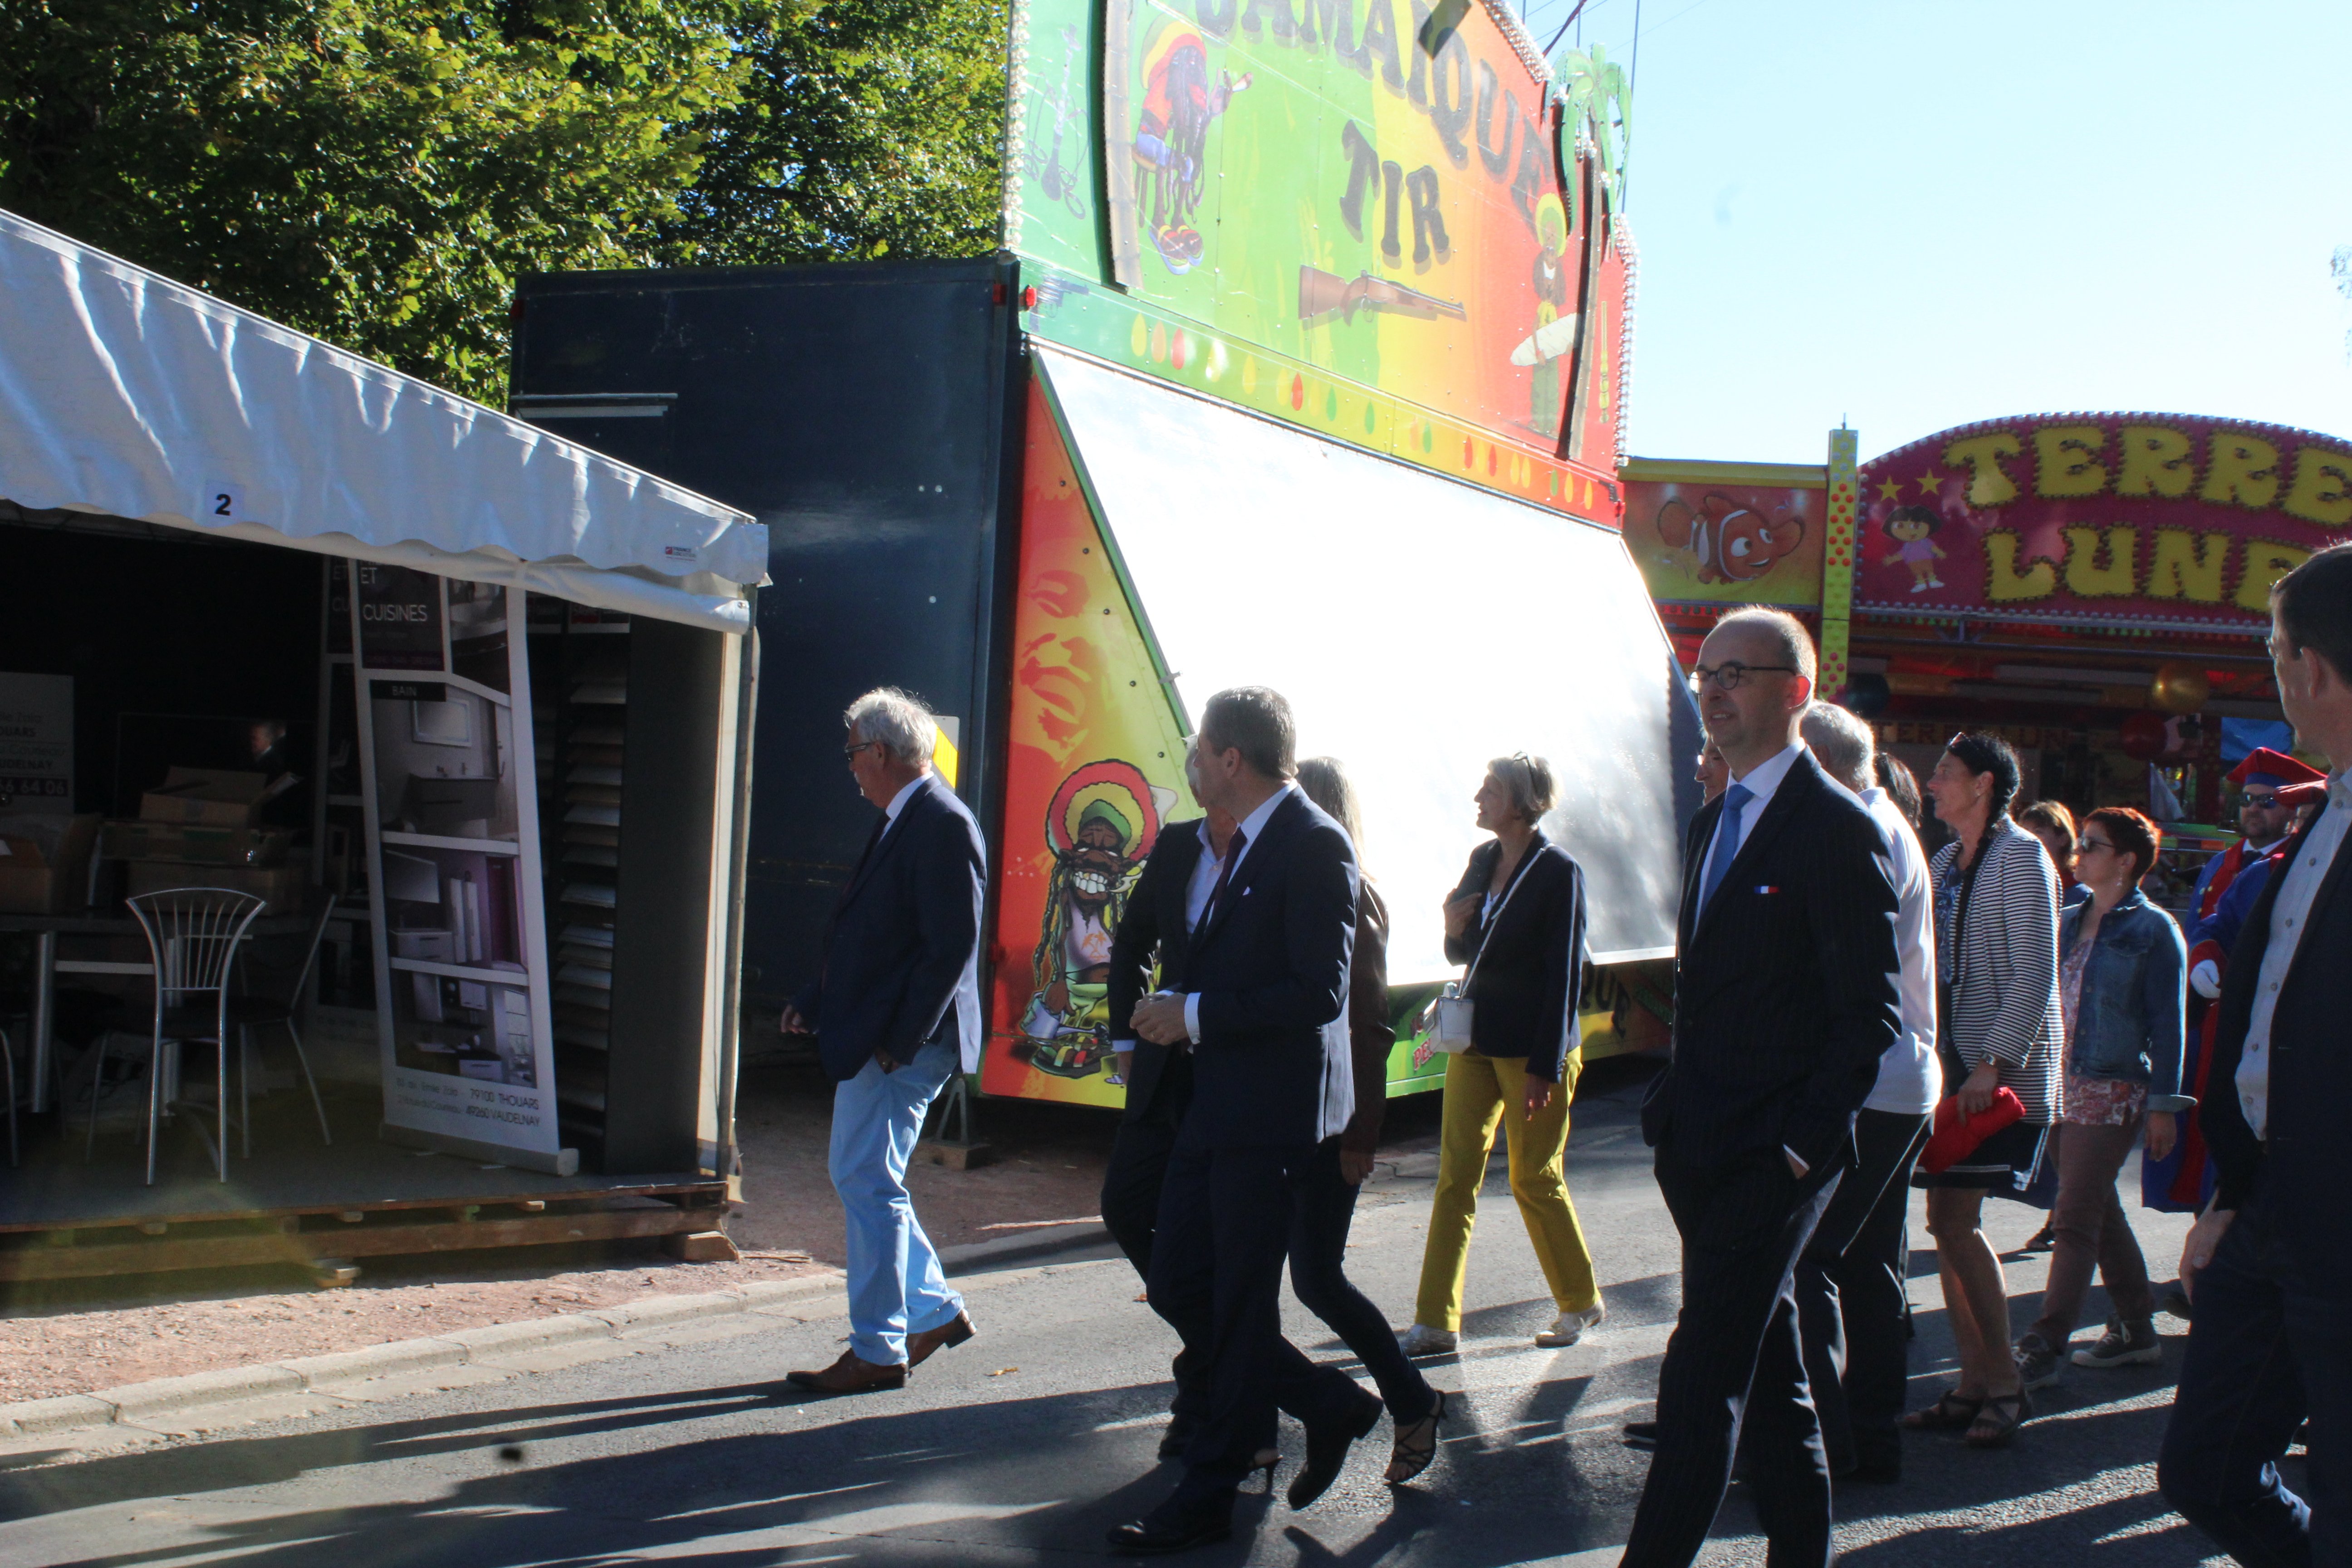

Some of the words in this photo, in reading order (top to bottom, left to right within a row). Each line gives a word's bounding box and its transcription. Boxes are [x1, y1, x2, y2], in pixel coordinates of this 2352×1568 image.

[1339, 119, 1450, 269] TIR
[1941, 420, 2352, 528] TERRE
[215, 494, 231, 516] 2
[361, 567, 377, 584] ET
[363, 604, 428, 622] CUISINES
[392, 686, 417, 696] BAIN
[20, 779, 40, 794] 64
[45, 780, 64, 794] 06
[498, 1093, 539, 1110] THOUARS
